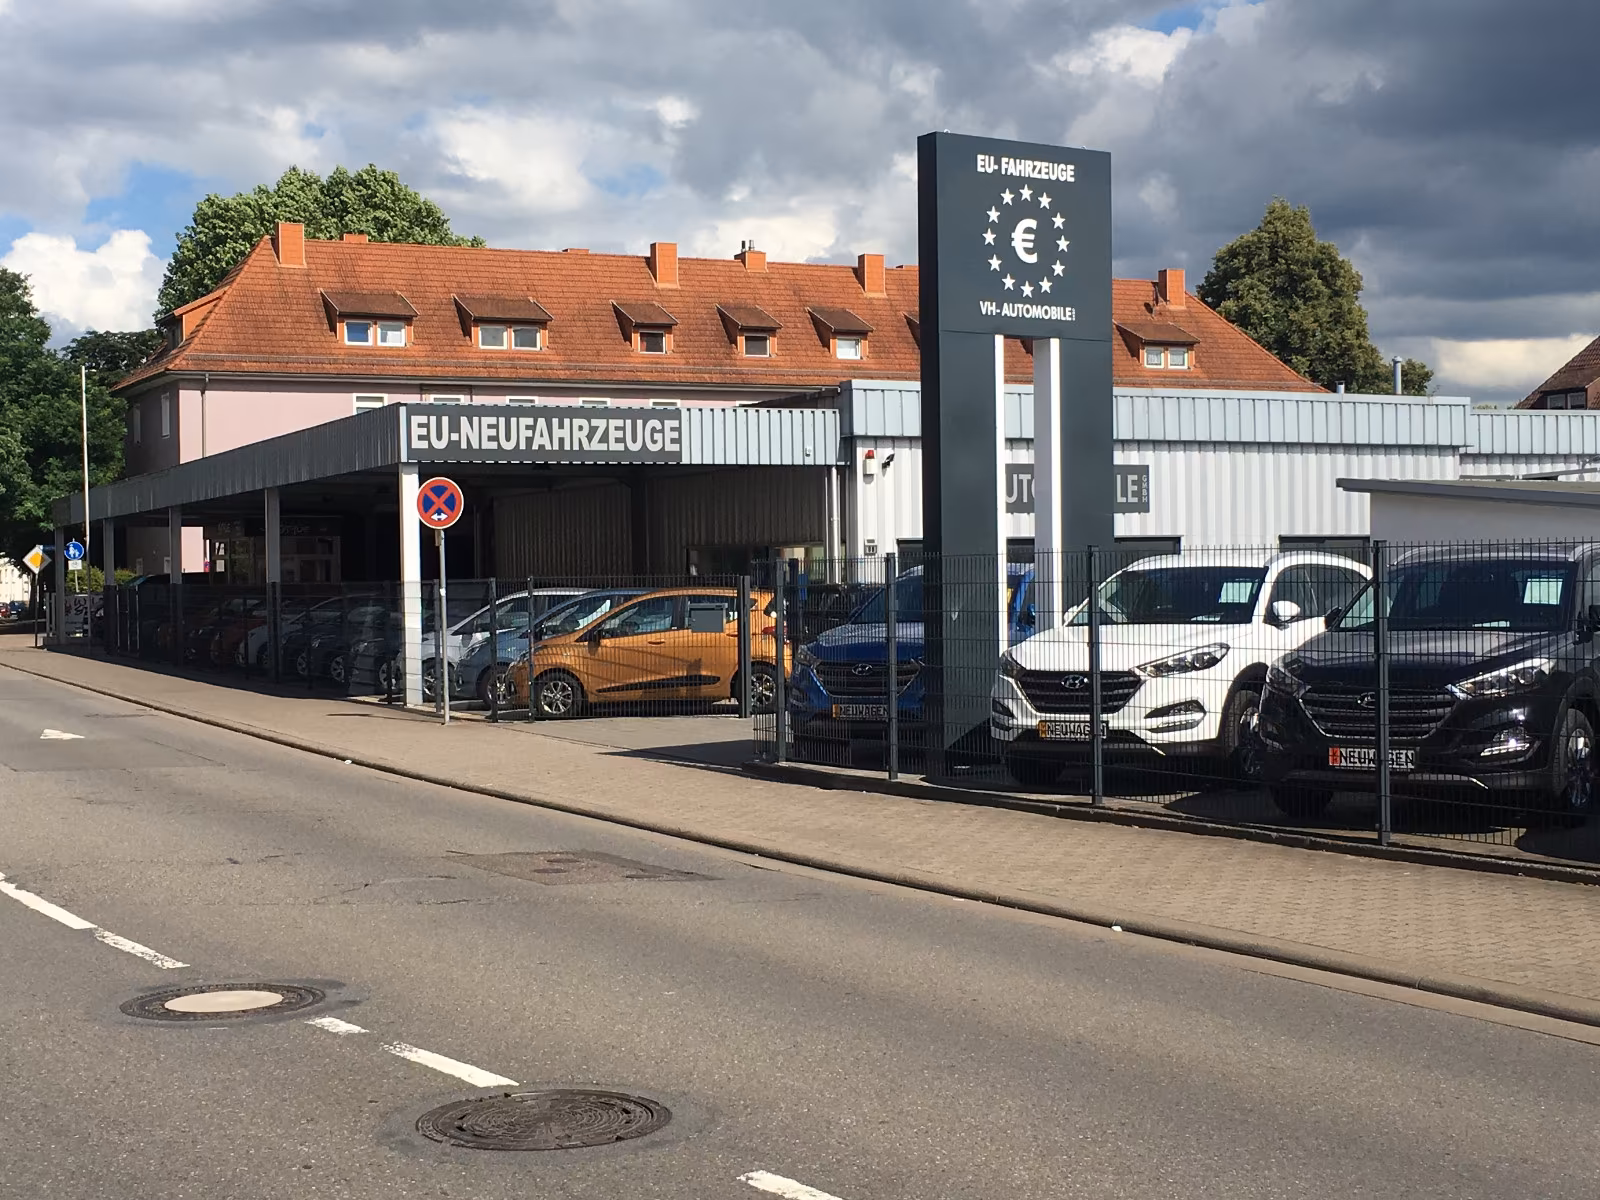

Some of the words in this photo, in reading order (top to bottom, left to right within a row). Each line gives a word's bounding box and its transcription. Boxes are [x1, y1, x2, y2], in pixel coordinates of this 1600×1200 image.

[976, 154, 998, 173] EU-
[1001, 156, 1075, 182] FAHRZEUGE
[979, 300, 1001, 316] VH-
[1001, 302, 1072, 321] AUTOMOBILE
[410, 415, 680, 452] EU-NEUFAHRZEUGE
